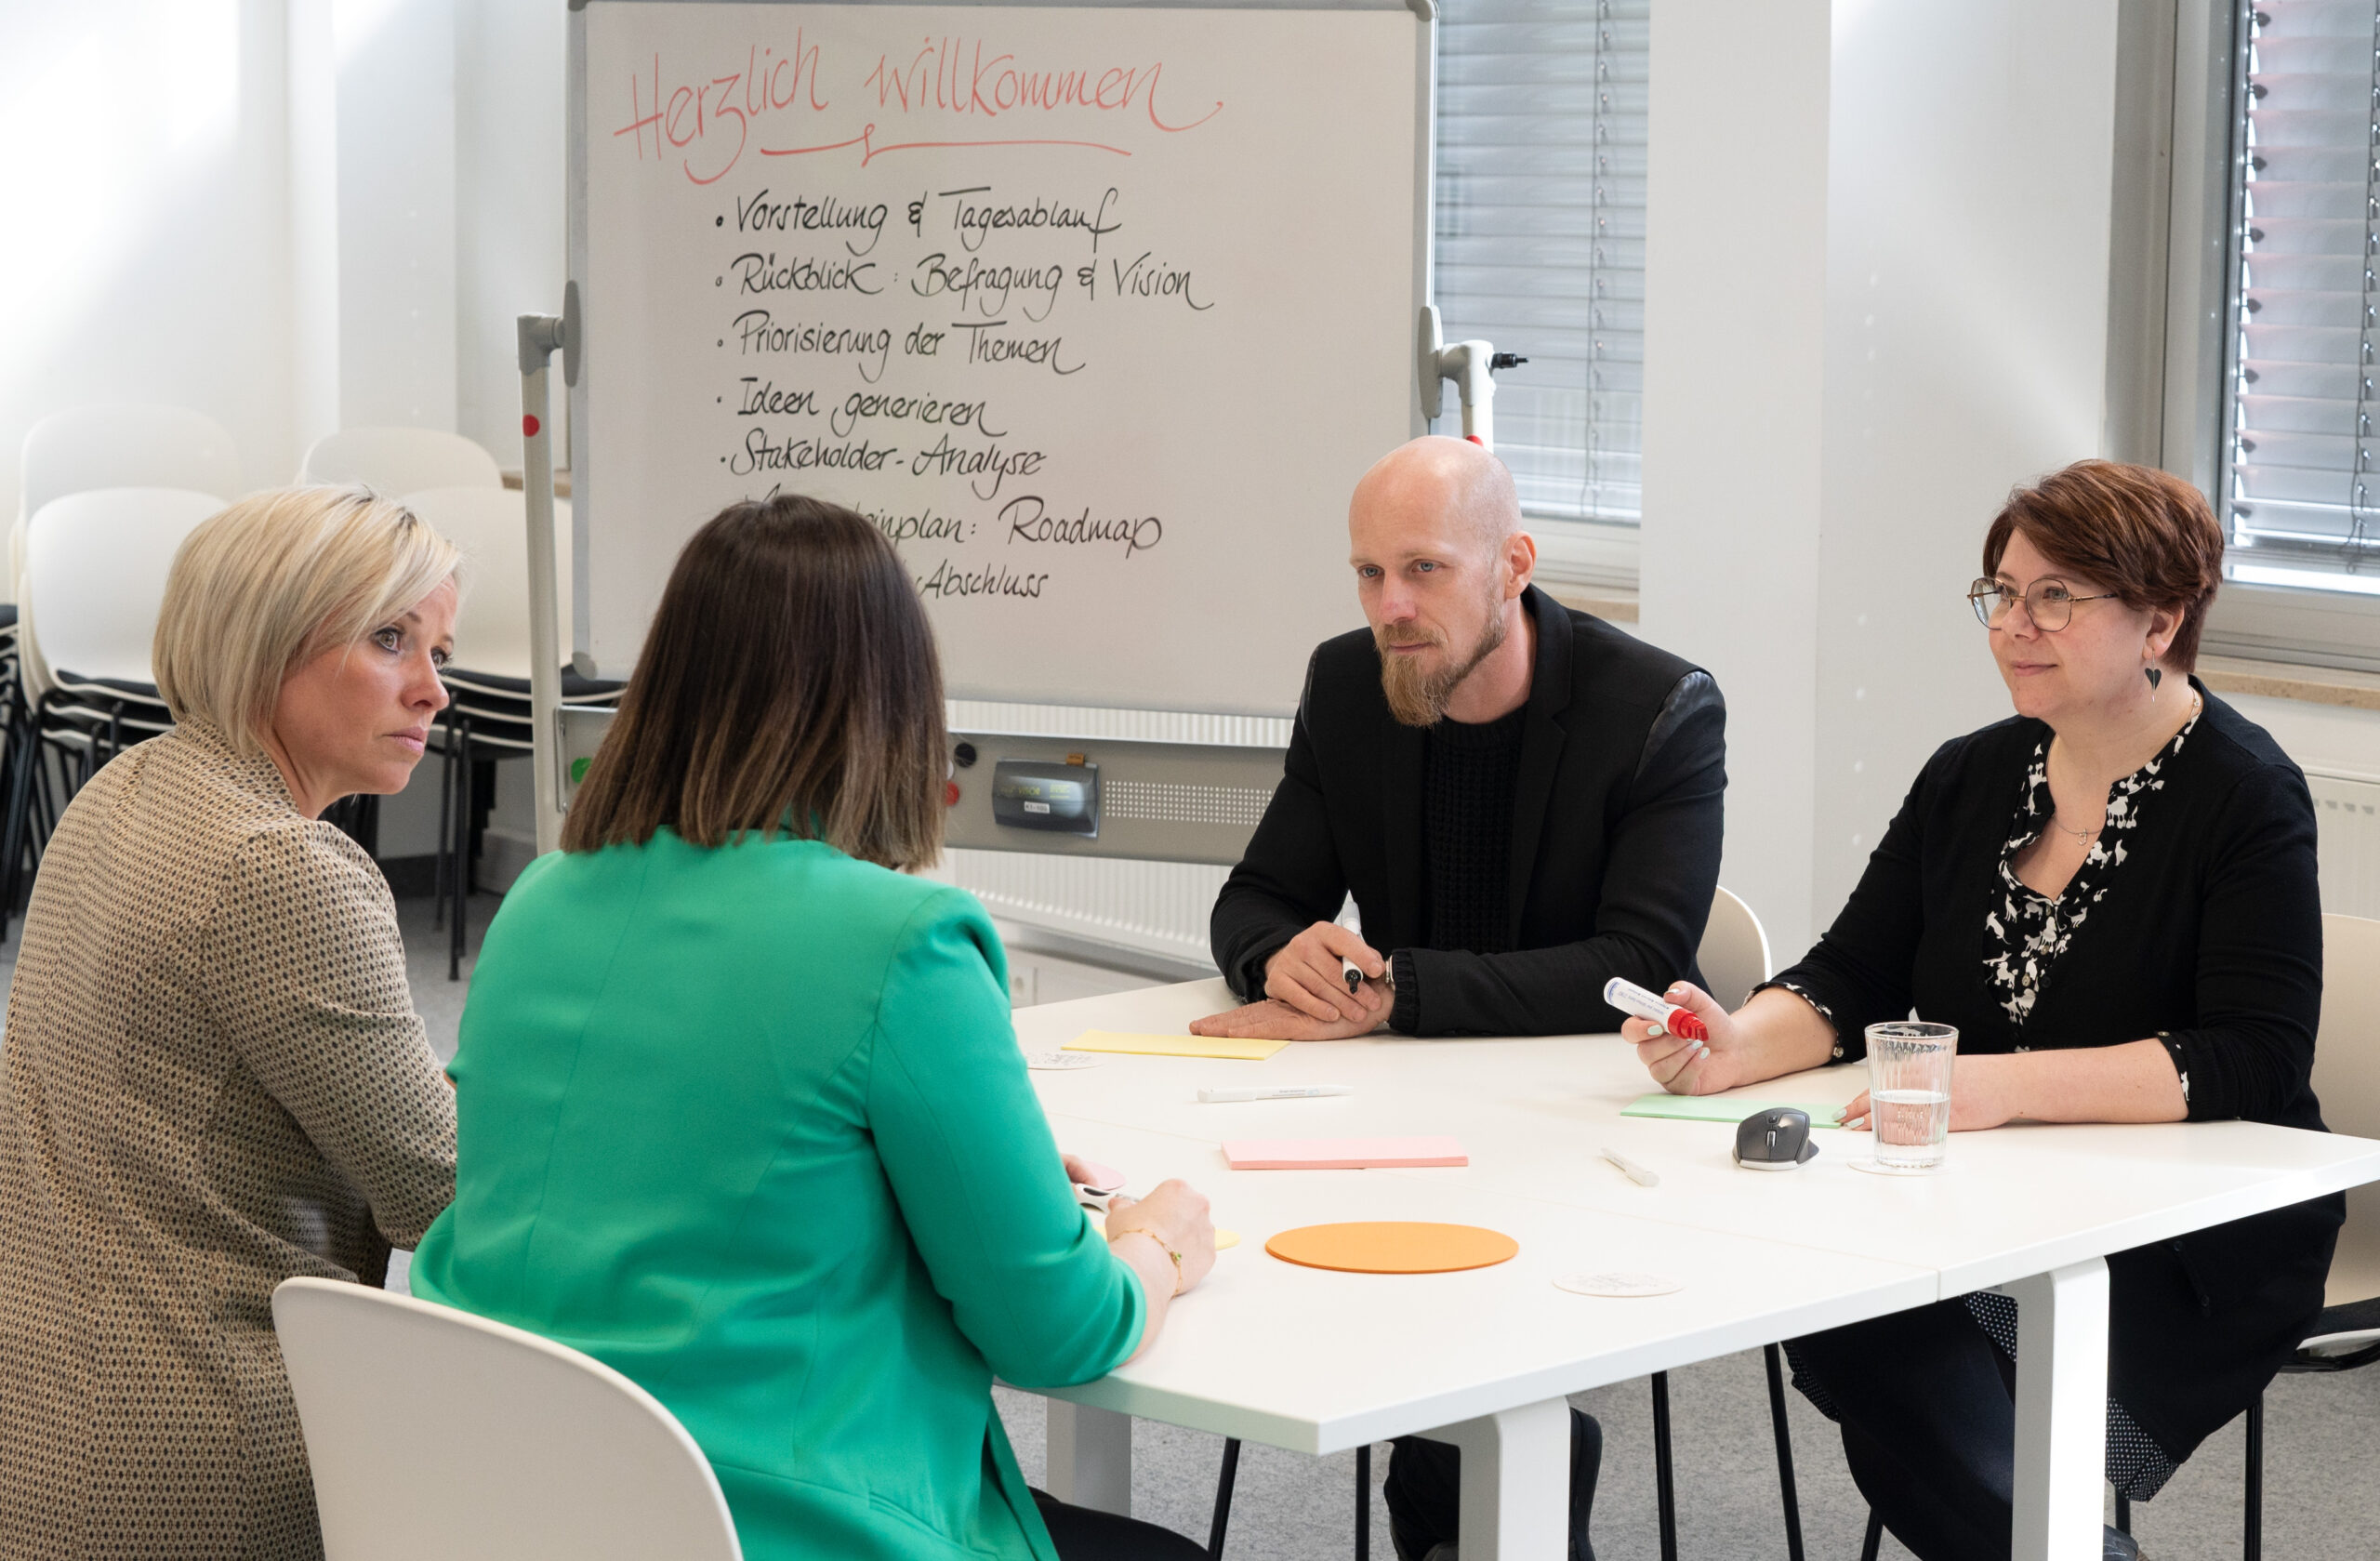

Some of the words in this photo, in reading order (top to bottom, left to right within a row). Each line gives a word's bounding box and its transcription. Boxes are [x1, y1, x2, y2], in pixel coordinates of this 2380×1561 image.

[614, 26, 828, 185] Herzlich
[734, 189, 888, 257] Vorstellung
[938, 187, 1122, 253] Tagesablauf
[911, 253, 1063, 322] Befragung
[1114, 251, 1214, 310] Vision
[733, 310, 890, 383] Priorisierung
[905, 322, 945, 357] der
[951, 321, 1086, 374] Themen
[737, 377, 819, 416] Ideen
[831, 392, 1008, 438] generieren
[998, 496, 1162, 560] Roadmap
[916, 558, 1050, 599] Abschluss
